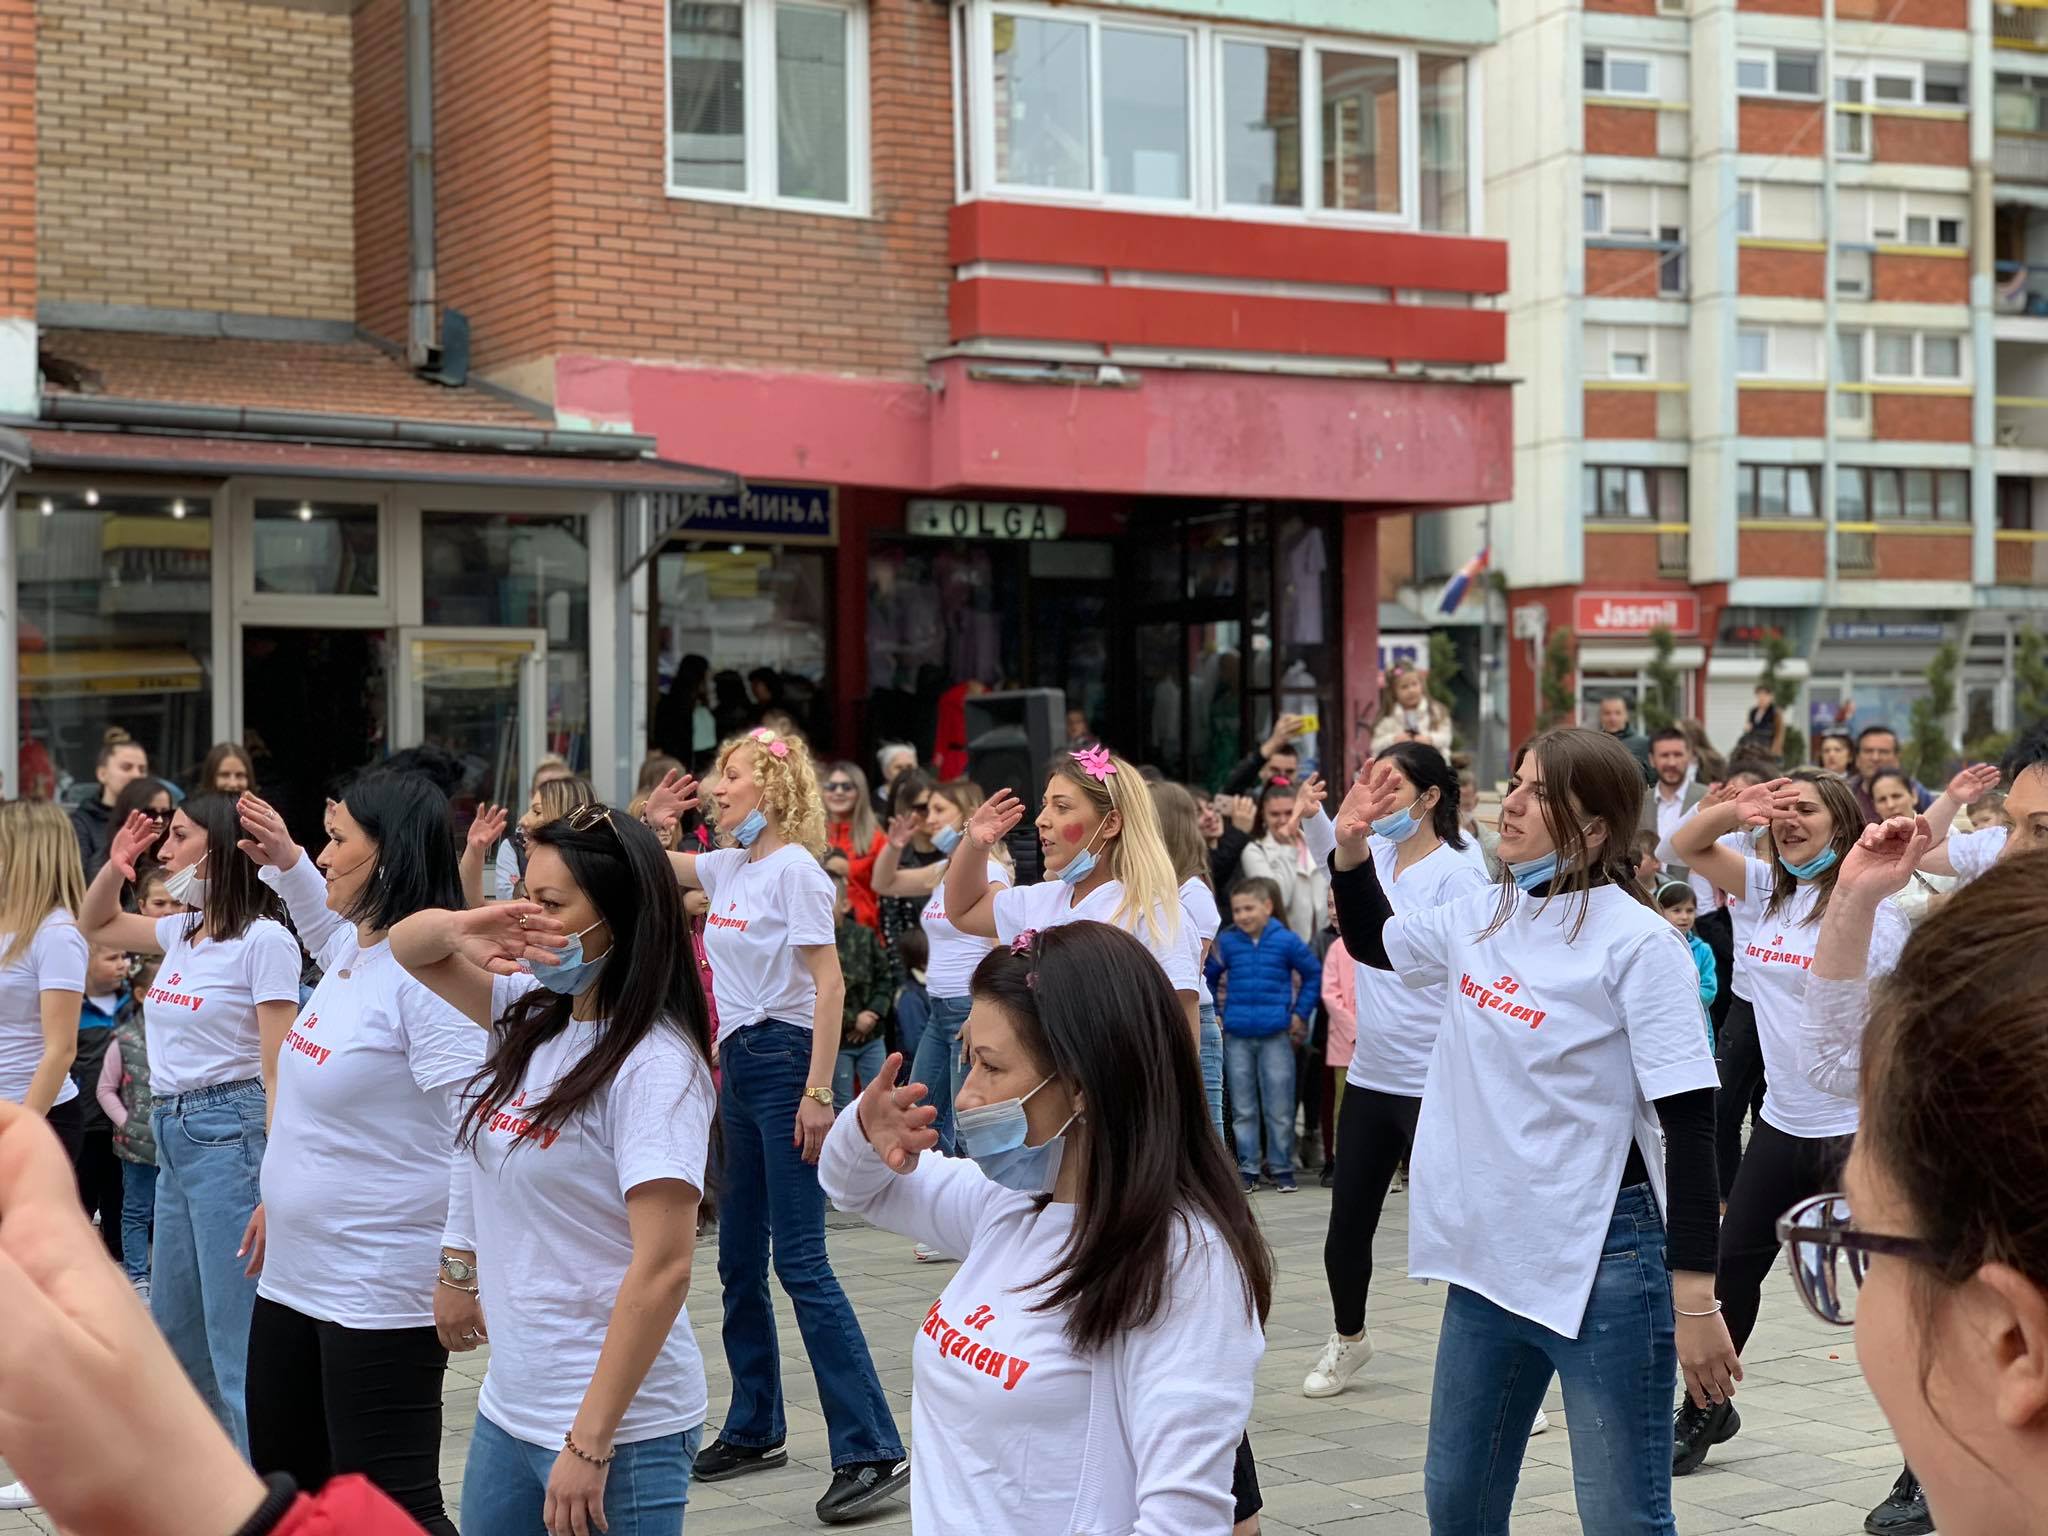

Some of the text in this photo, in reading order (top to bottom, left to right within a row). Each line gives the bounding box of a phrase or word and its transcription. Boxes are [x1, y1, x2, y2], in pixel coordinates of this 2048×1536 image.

[951, 503, 1047, 540] OLGA
[1594, 600, 1678, 628] Jasmil
[168, 973, 181, 985] За
[1493, 975, 1519, 995] За
[147, 984, 204, 1011] агдалену
[1459, 973, 1546, 1030] Магдалену
[286, 1029, 332, 1066] агдалену
[964, 1304, 995, 1331] За
